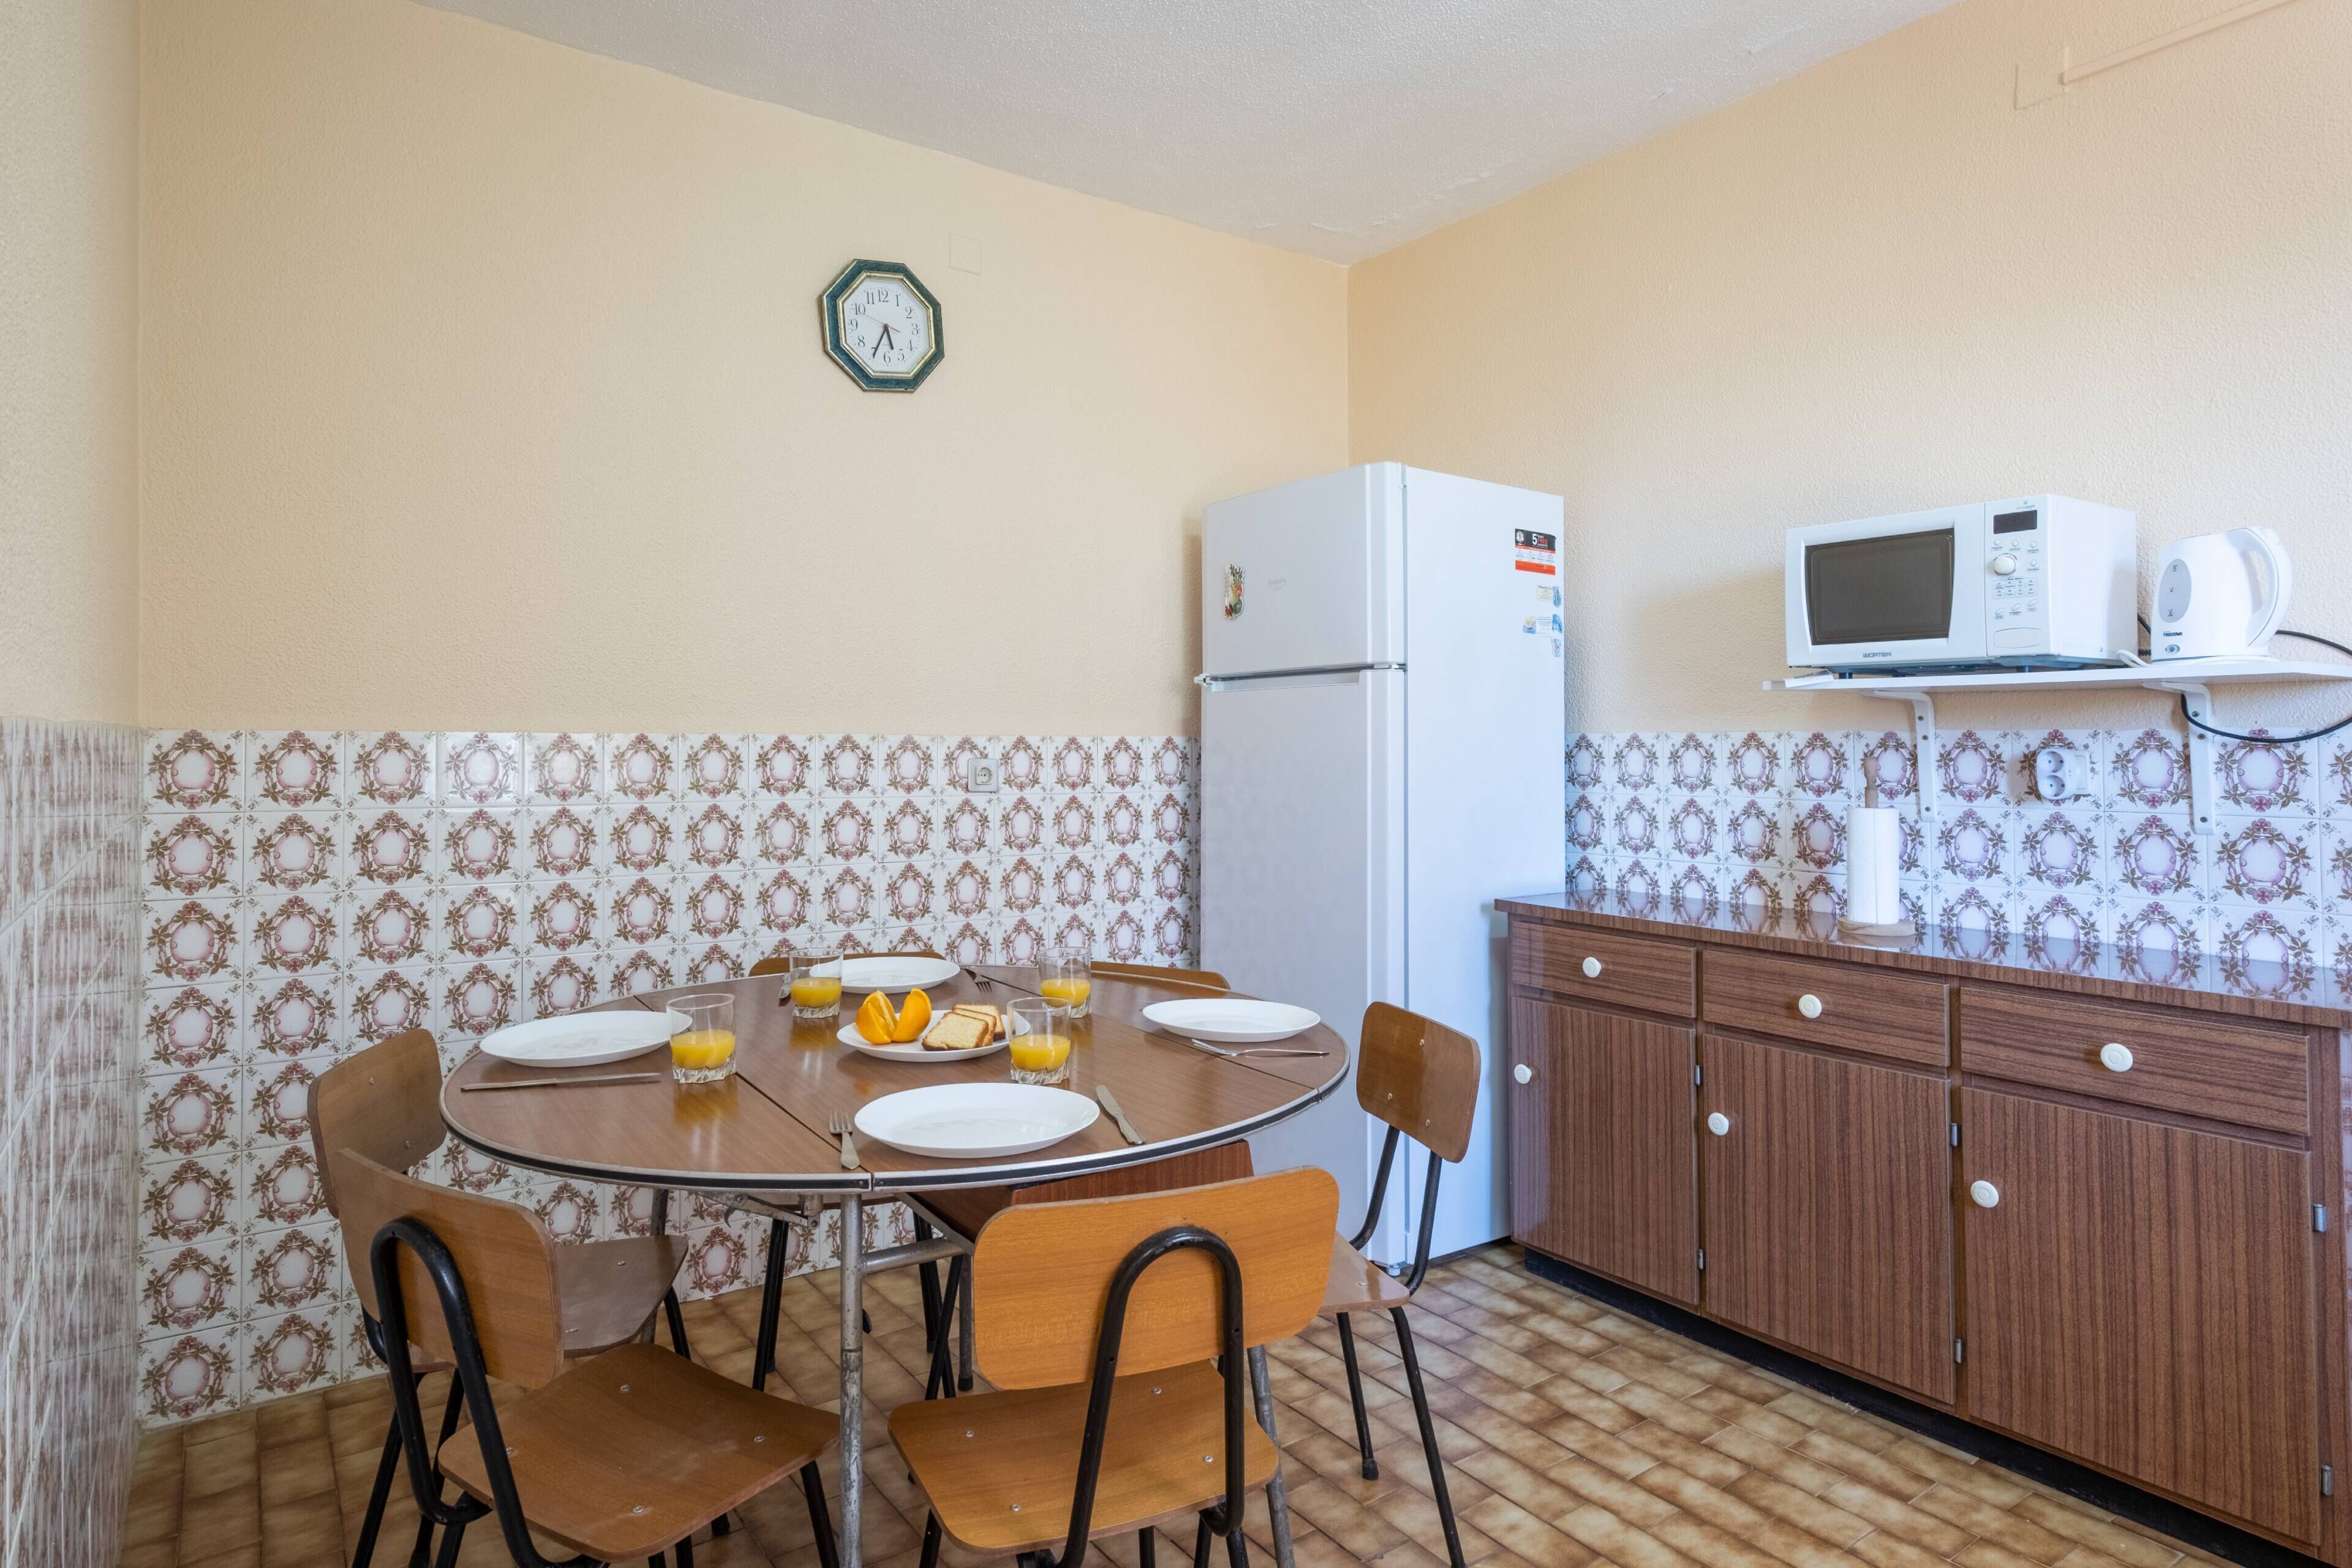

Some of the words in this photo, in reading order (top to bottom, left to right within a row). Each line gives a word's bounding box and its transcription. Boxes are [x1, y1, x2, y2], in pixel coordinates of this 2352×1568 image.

[867, 292, 875, 304] 11
[878, 290, 889, 303] 12
[854, 303, 865, 315] 10
[905, 307, 912, 318] 2
[850, 318, 858, 331] 9
[911, 323, 919, 336] 3
[858, 335, 865, 348] 8
[907, 339, 914, 351] 4
[883, 351, 891, 363] 6
[897, 349, 905, 361] 5
[1532, 533, 1537, 545] 5
